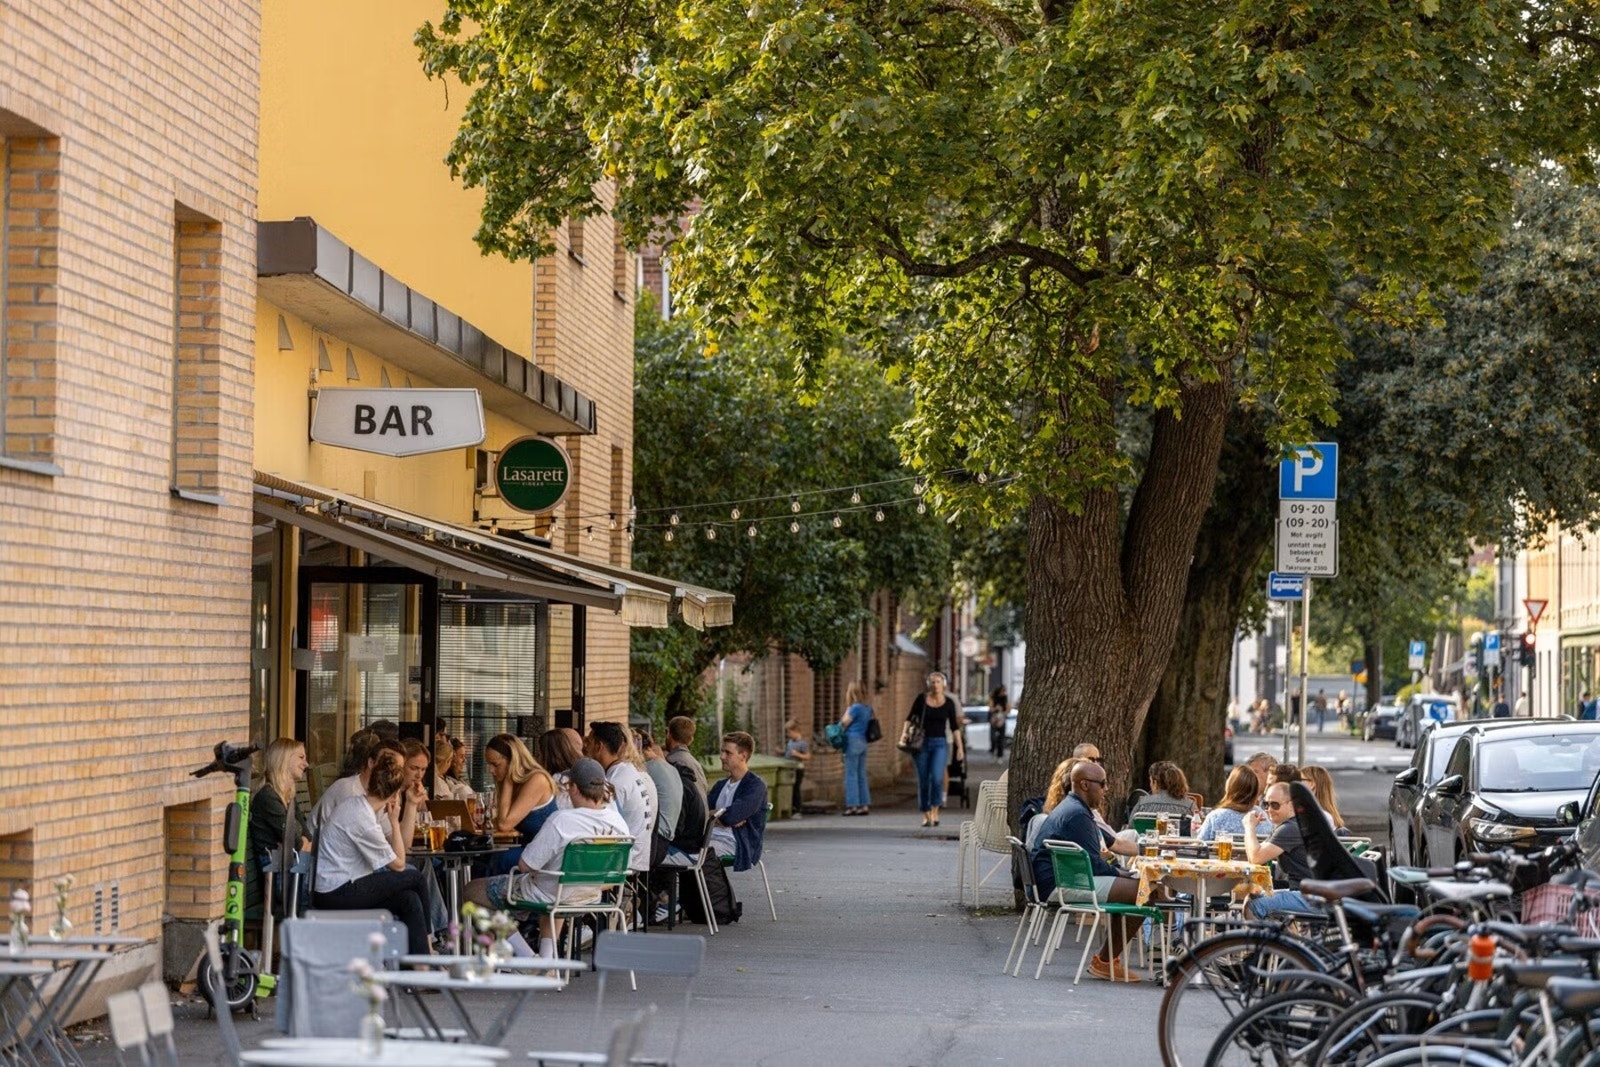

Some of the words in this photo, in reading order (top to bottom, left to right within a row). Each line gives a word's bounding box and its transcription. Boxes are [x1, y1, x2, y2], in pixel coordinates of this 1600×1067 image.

[354, 404, 434, 436] BAR
[503, 466, 564, 481] Lasarett
[1294, 450, 1324, 492] P
